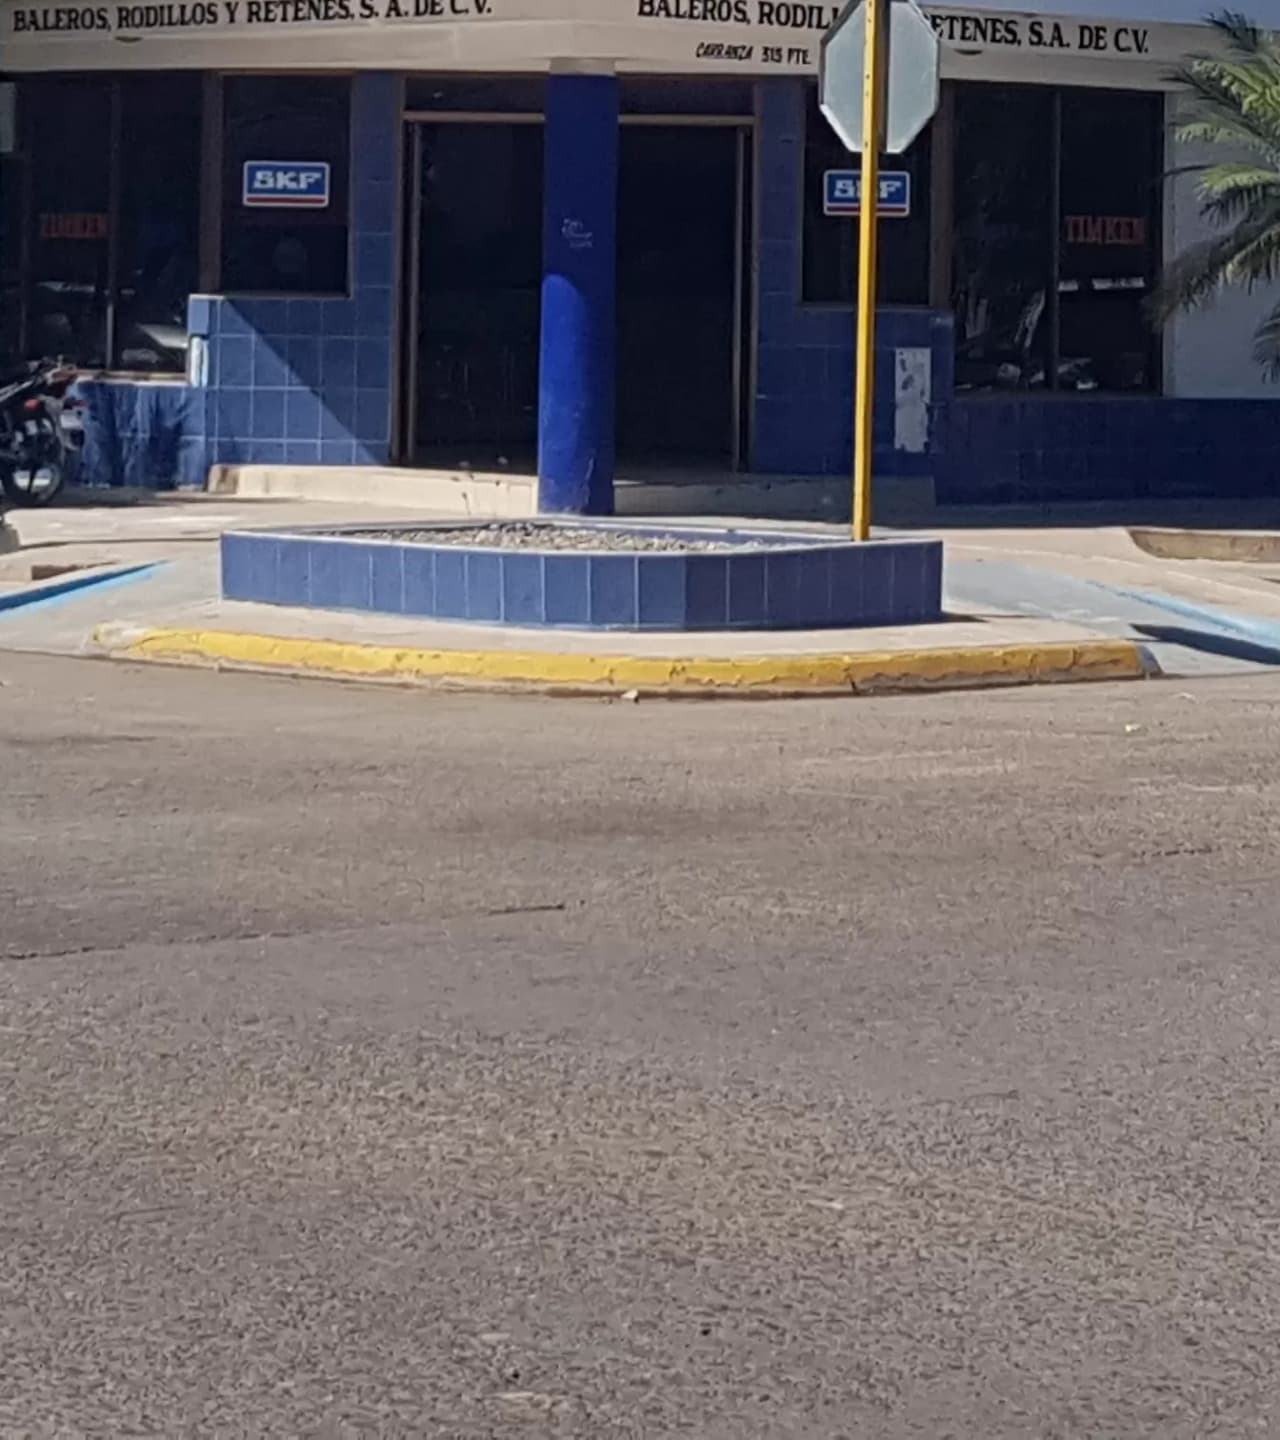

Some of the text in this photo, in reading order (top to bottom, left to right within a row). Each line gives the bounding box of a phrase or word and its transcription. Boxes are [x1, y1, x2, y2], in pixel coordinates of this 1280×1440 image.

[13, 7, 111, 34] BALEROS,
[117, 2, 218, 30] RODILLOS
[225, 1, 239, 23] Y
[926, 14, 1023, 47] ETENES,
[1078, 25, 1107, 51] DE
[761, 45, 783, 63] 315
[252, 170, 322, 190] SKF
[833, 178, 902, 199] SF
[1063, 215, 1145, 245] TIMKEN
